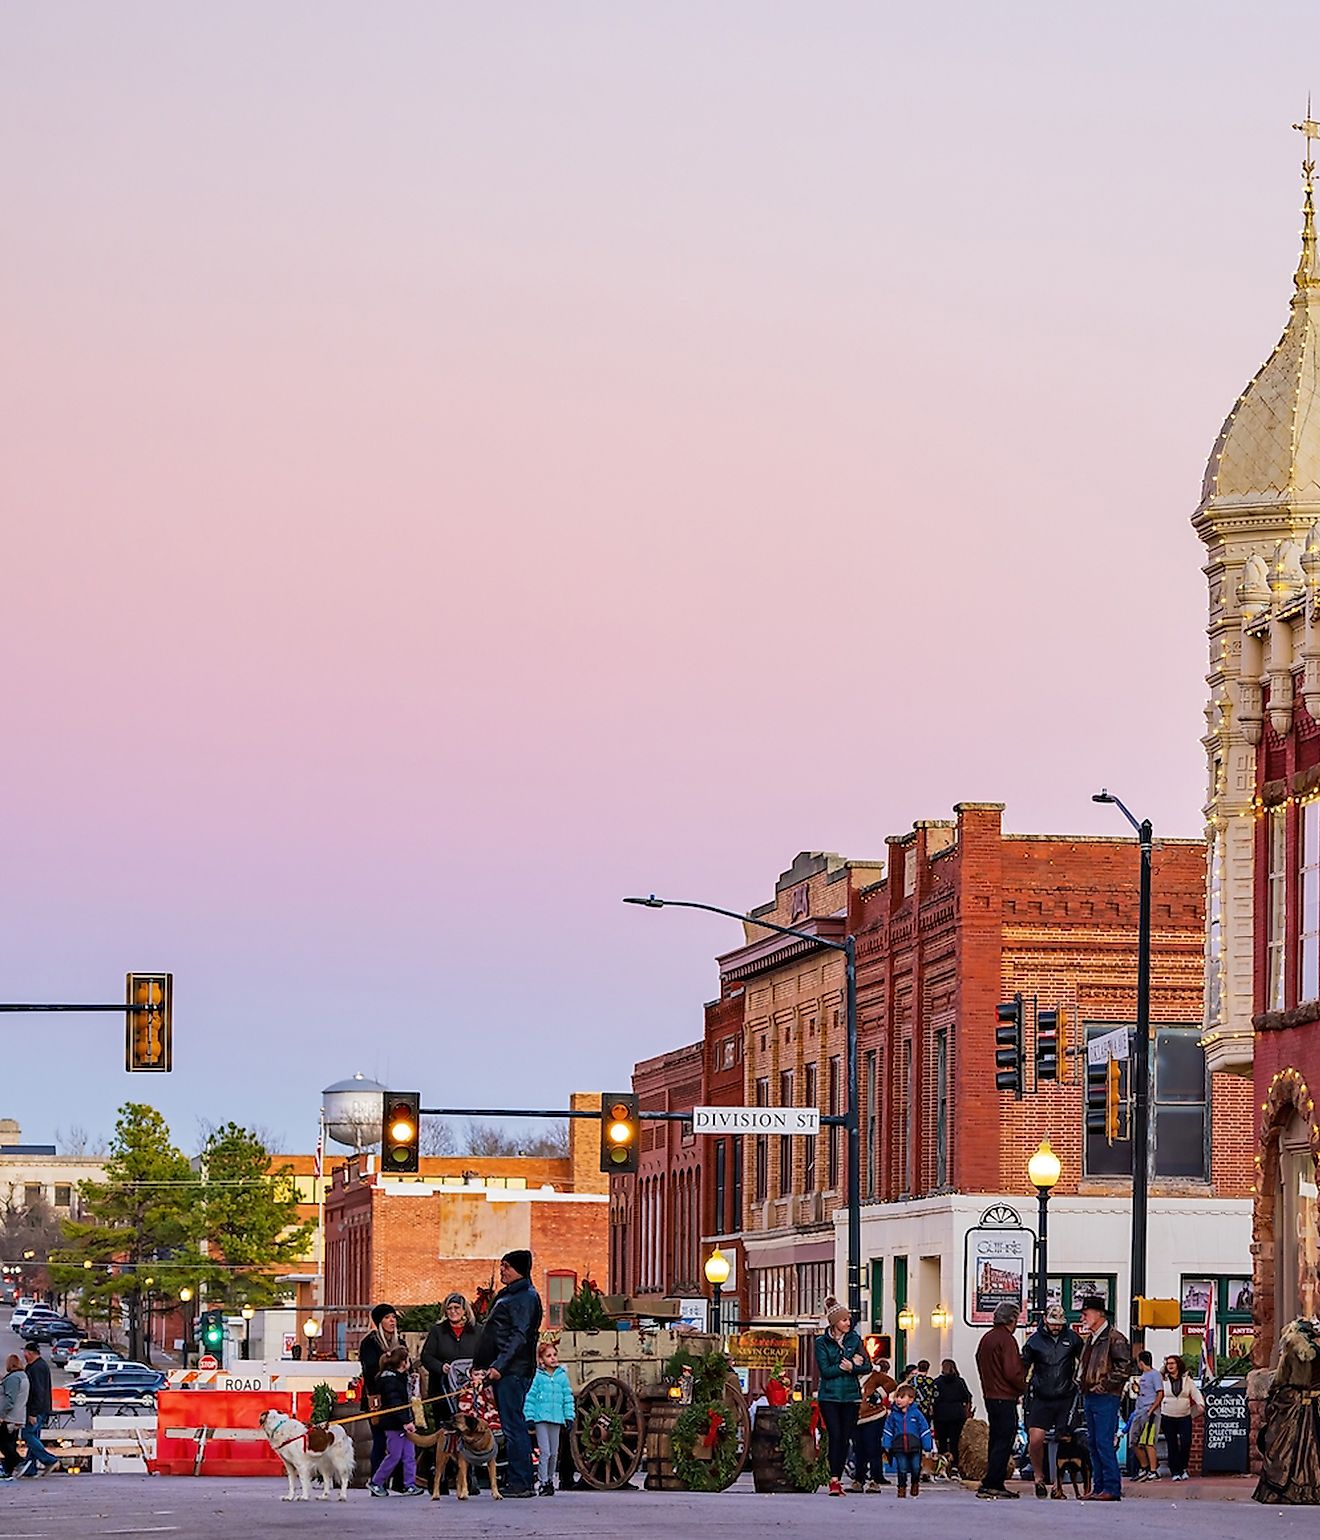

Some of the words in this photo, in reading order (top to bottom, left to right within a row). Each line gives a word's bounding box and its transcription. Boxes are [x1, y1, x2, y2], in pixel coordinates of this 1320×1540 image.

[696, 1112, 786, 1128] DIVISION
[796, 1114, 818, 1128] ST
[199, 1361, 216, 1369] STOP
[225, 1379, 262, 1391] ROAD
[1208, 1441, 1226, 1449] GIFTS
